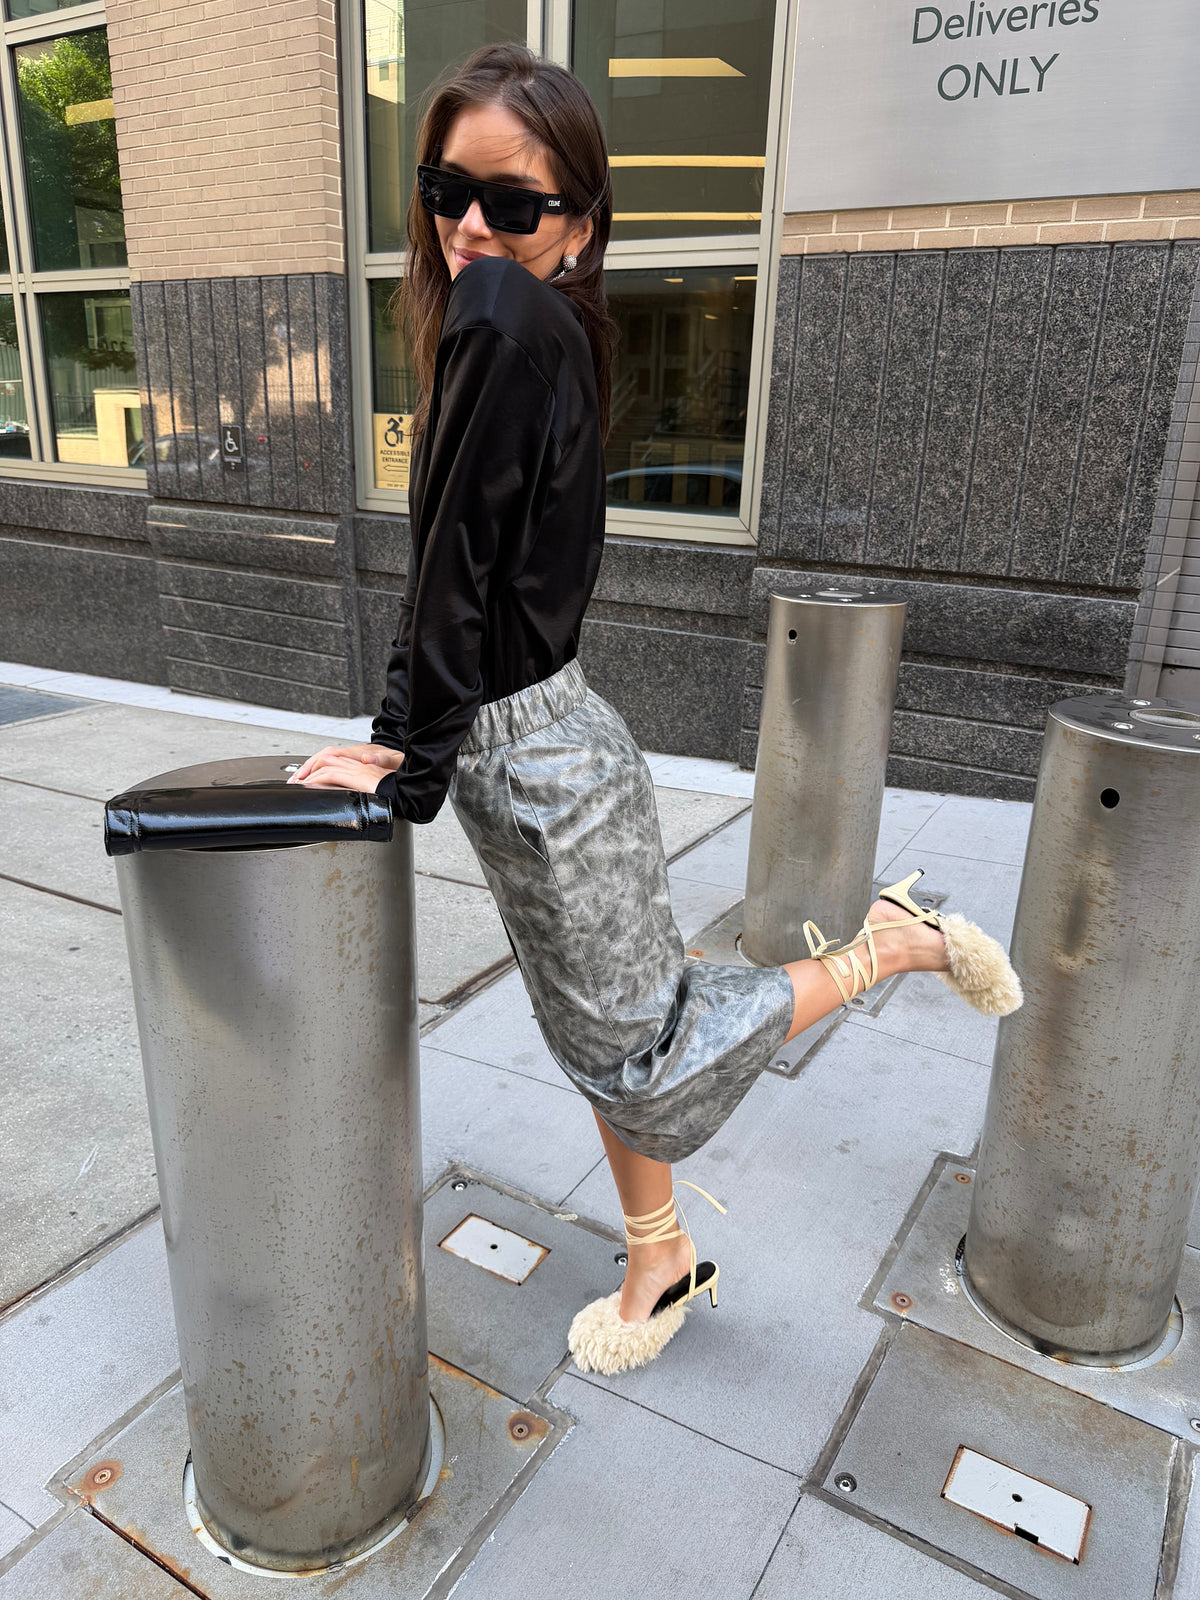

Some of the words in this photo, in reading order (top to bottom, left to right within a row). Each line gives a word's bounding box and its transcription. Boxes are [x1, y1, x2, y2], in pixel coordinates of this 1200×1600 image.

[912, 0, 1100, 44] Deliveries
[937, 53, 1060, 101] ONLY
[382, 456, 408, 464] ENTRANCE
